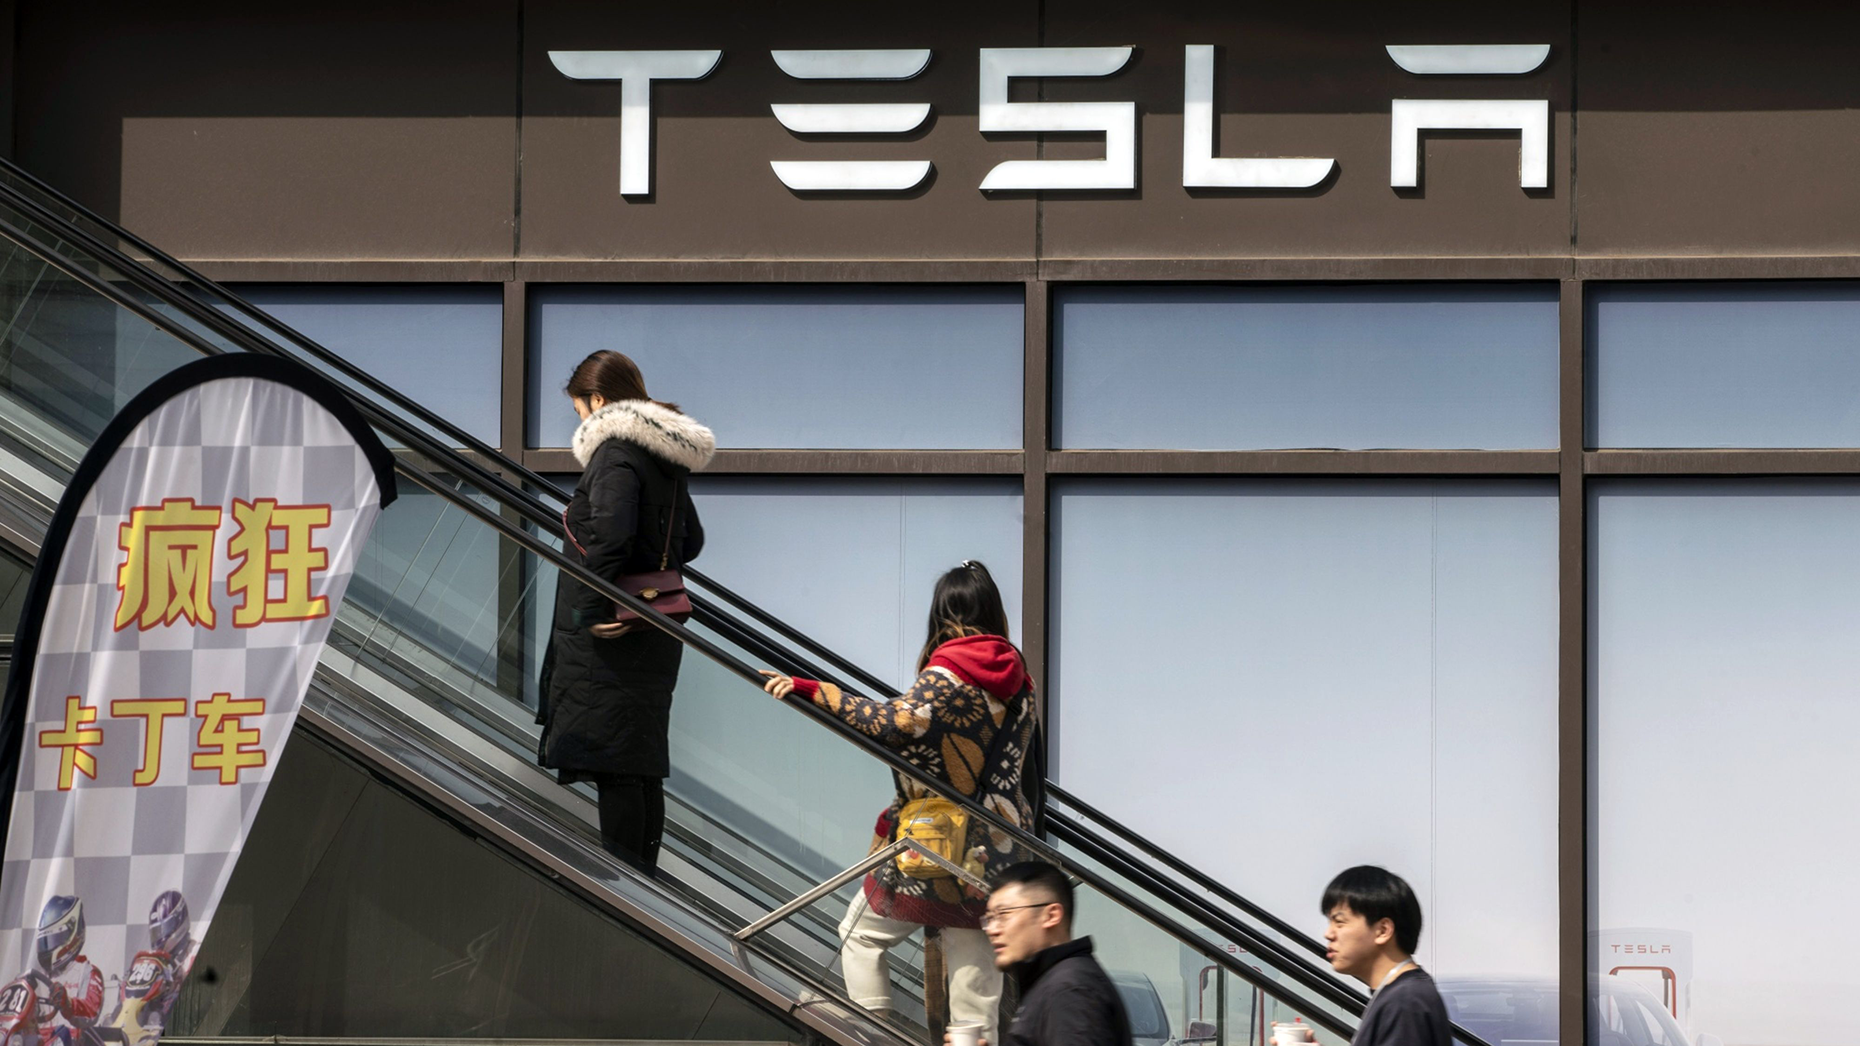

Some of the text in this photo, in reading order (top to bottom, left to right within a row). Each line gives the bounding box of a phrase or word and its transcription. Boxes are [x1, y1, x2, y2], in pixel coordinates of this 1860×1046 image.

[548, 45, 1551, 195] TESLA
[114, 497, 331, 632] 疯狂
[39, 692, 266, 791] 卡丁车
[1611, 944, 1671, 954] TESLA
